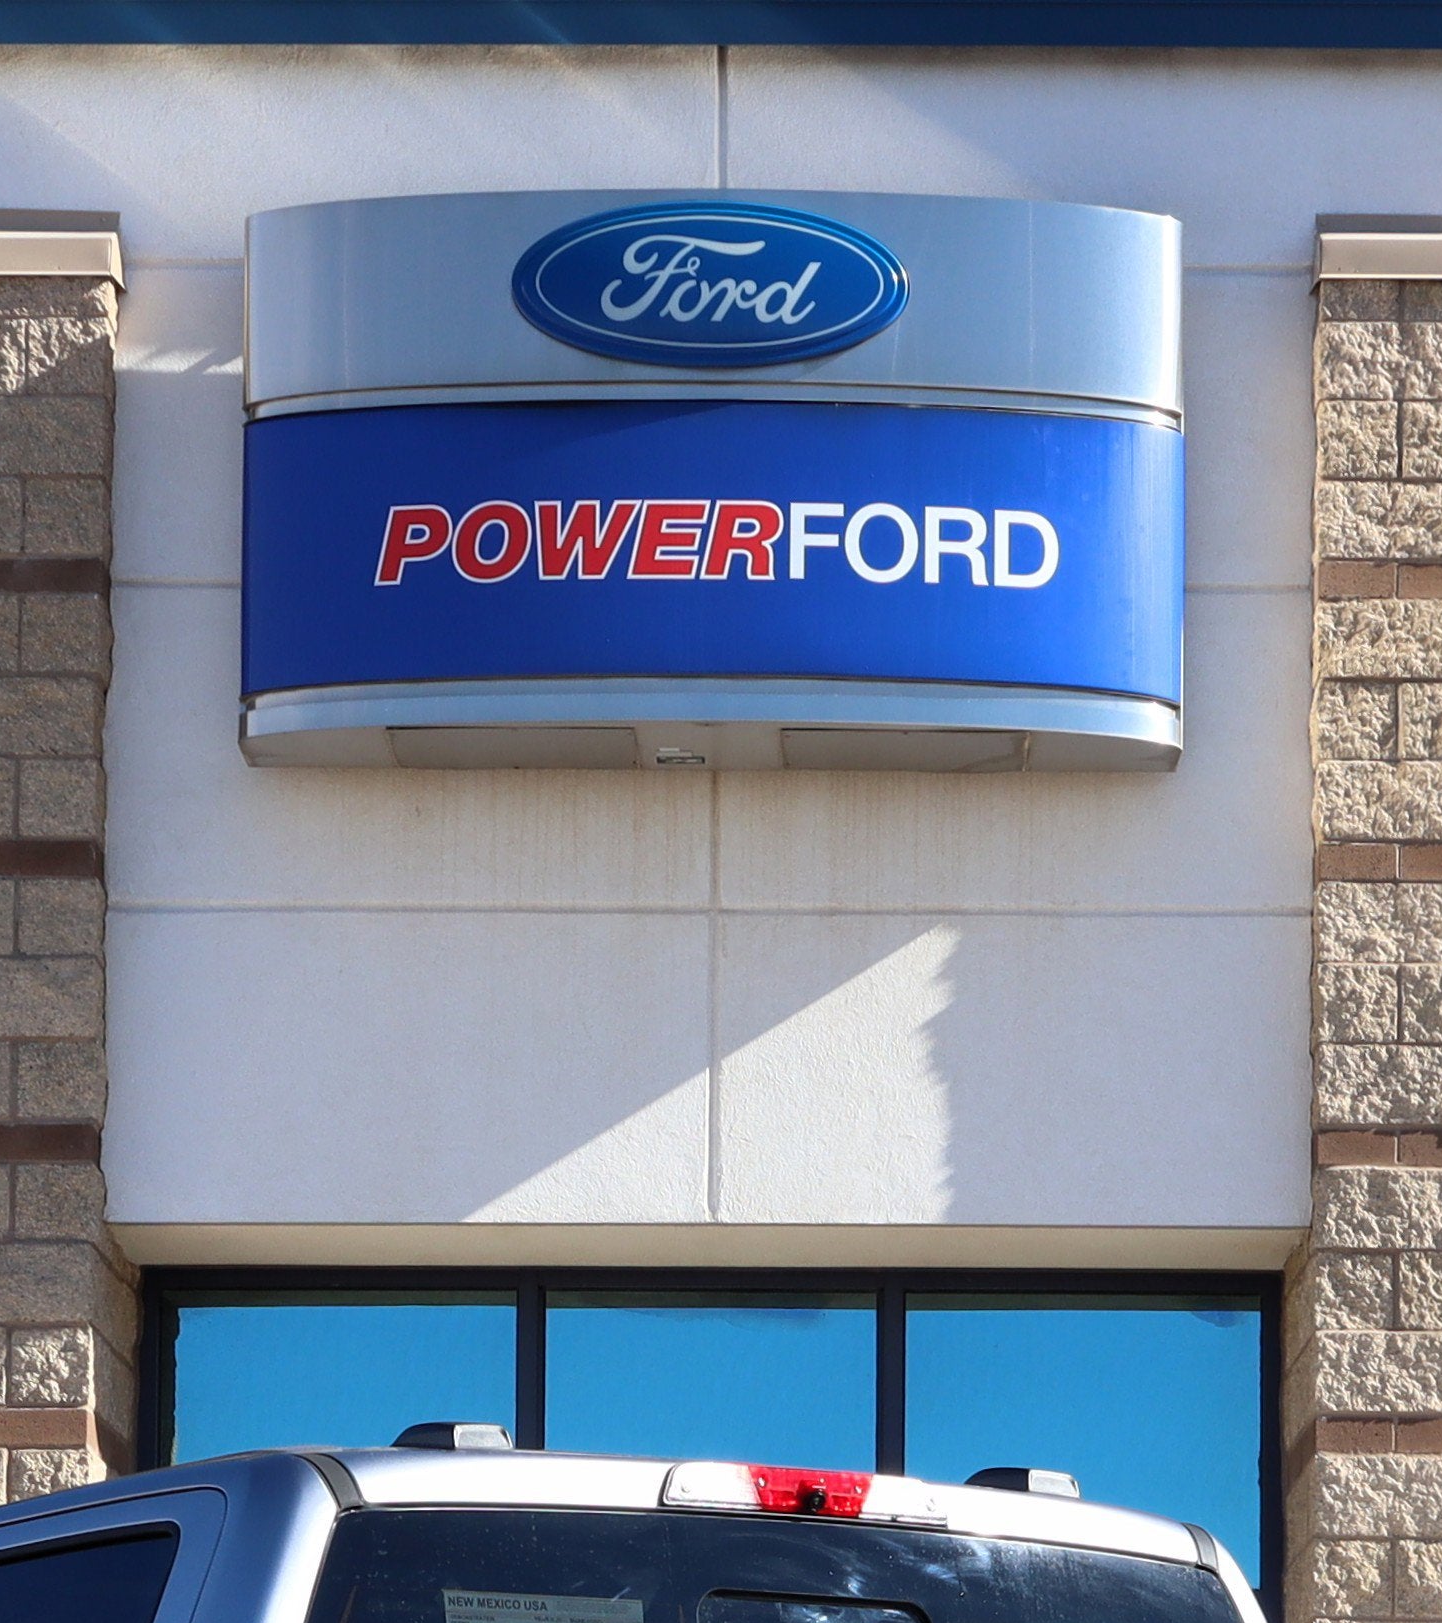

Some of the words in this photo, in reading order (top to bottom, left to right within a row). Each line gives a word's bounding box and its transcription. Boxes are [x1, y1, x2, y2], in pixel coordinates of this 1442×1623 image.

[600, 233, 823, 325] Ford
[447, 1595, 474, 1608] NEW
[476, 1597, 521, 1611] MEXICO
[523, 1600, 548, 1612] USA
